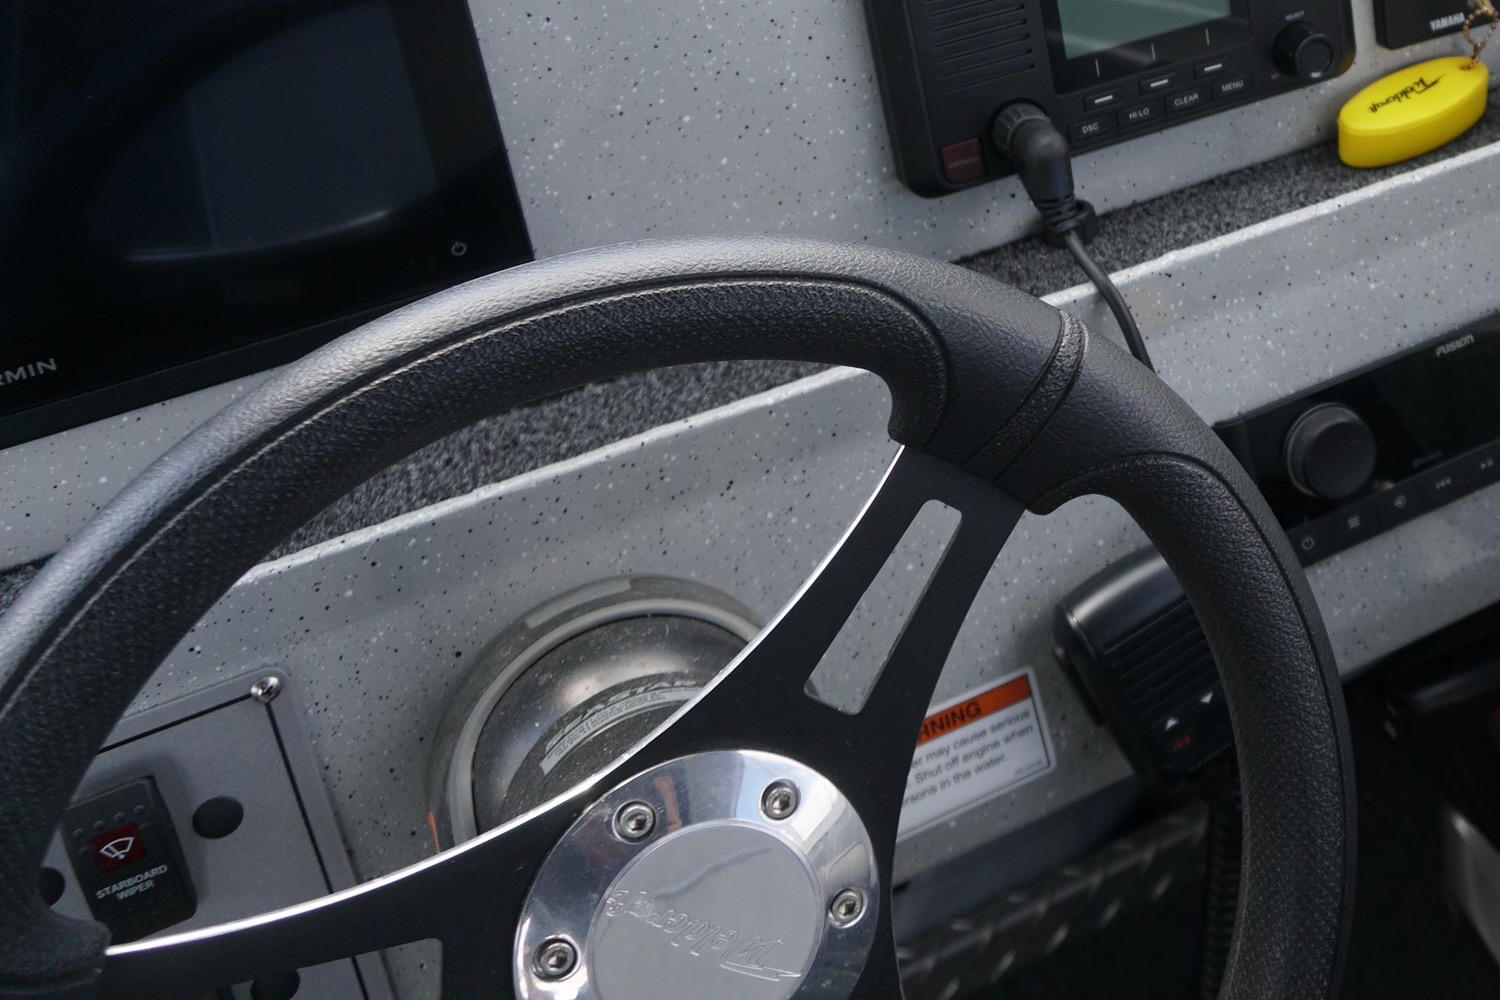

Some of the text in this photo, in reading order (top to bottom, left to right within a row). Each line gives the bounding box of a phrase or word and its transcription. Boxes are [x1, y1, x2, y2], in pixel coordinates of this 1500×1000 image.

[1429, 12, 1466, 32] YAMAHA
[1221, 80, 1245, 92] MENU
[1173, 93, 1199, 107] CLEAR
[1081, 122, 1100, 134] DSC
[0, 357, 57, 386] MIN
[924, 745, 950, 762] may
[952, 730, 988, 751] cause
[989, 709, 1032, 734] serious
[914, 725, 1035, 785] Shut off engine when
[938, 779, 951, 791] in
[952, 770, 972, 784] the
[96, 864, 168, 899] STARBOARD
[115, 880, 155, 899] WIPER
